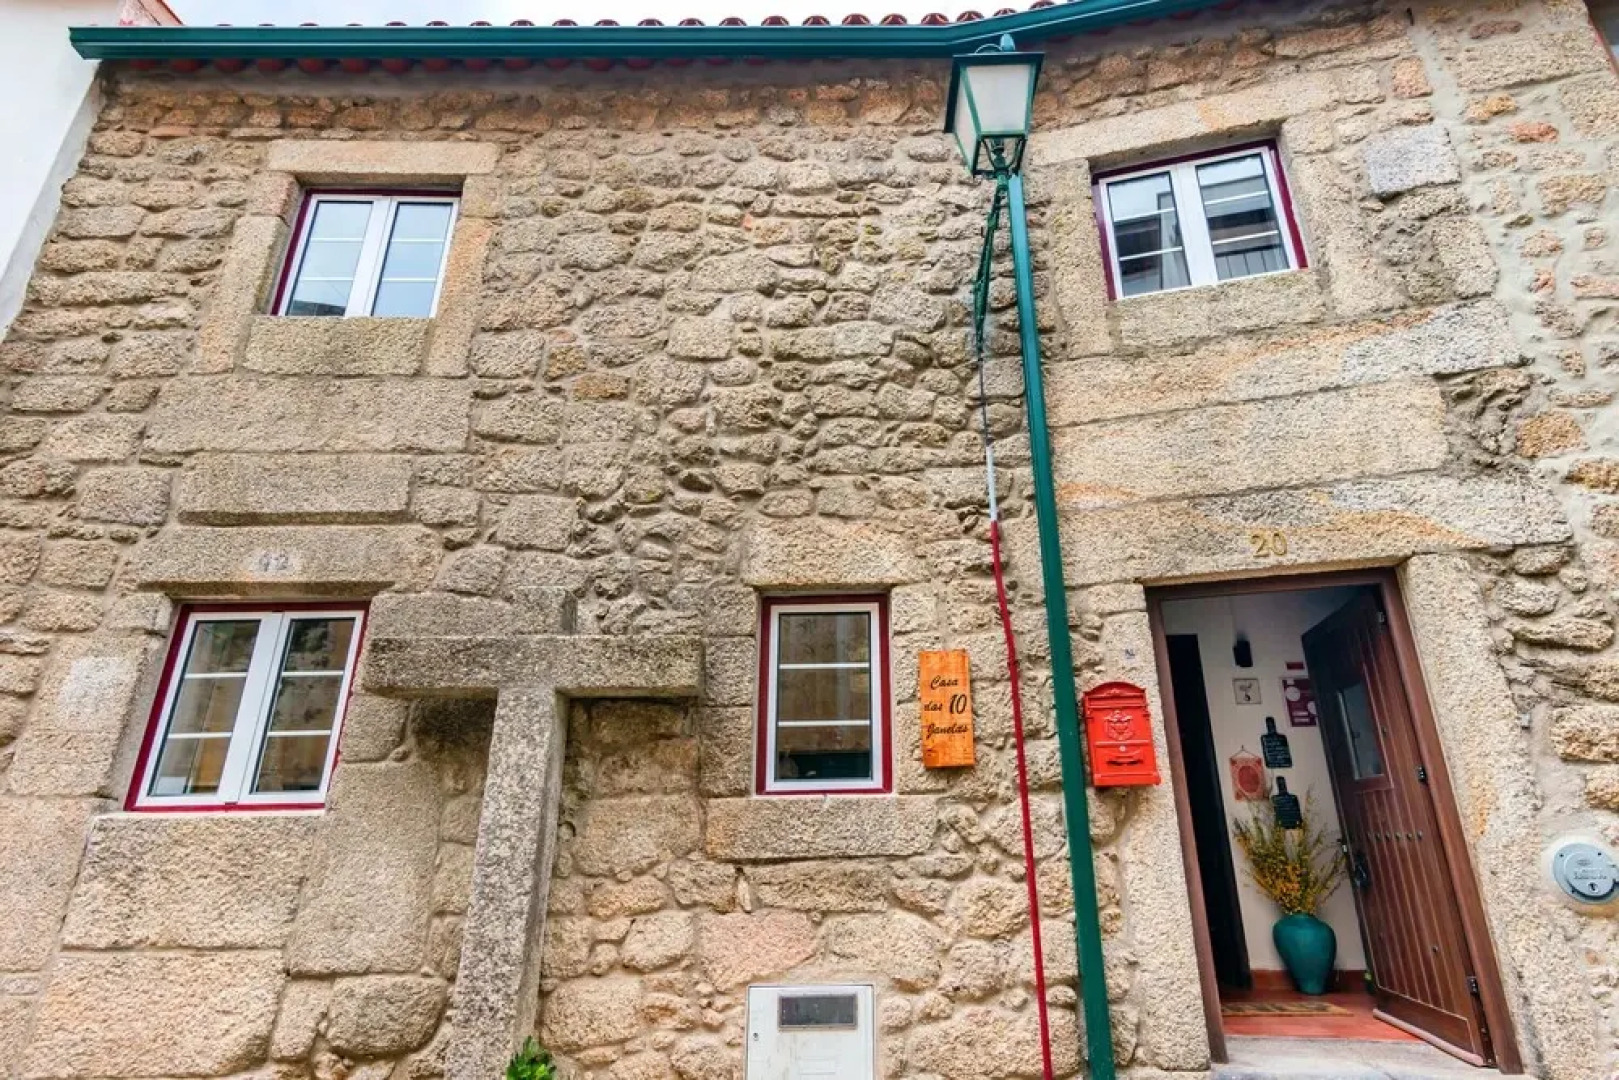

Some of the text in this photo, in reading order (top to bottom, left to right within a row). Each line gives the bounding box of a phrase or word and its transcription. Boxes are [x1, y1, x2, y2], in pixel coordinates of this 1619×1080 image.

[1250, 529, 1287, 557] 20
[930, 675, 958, 690] Casa
[949, 694, 967, 714] 10
